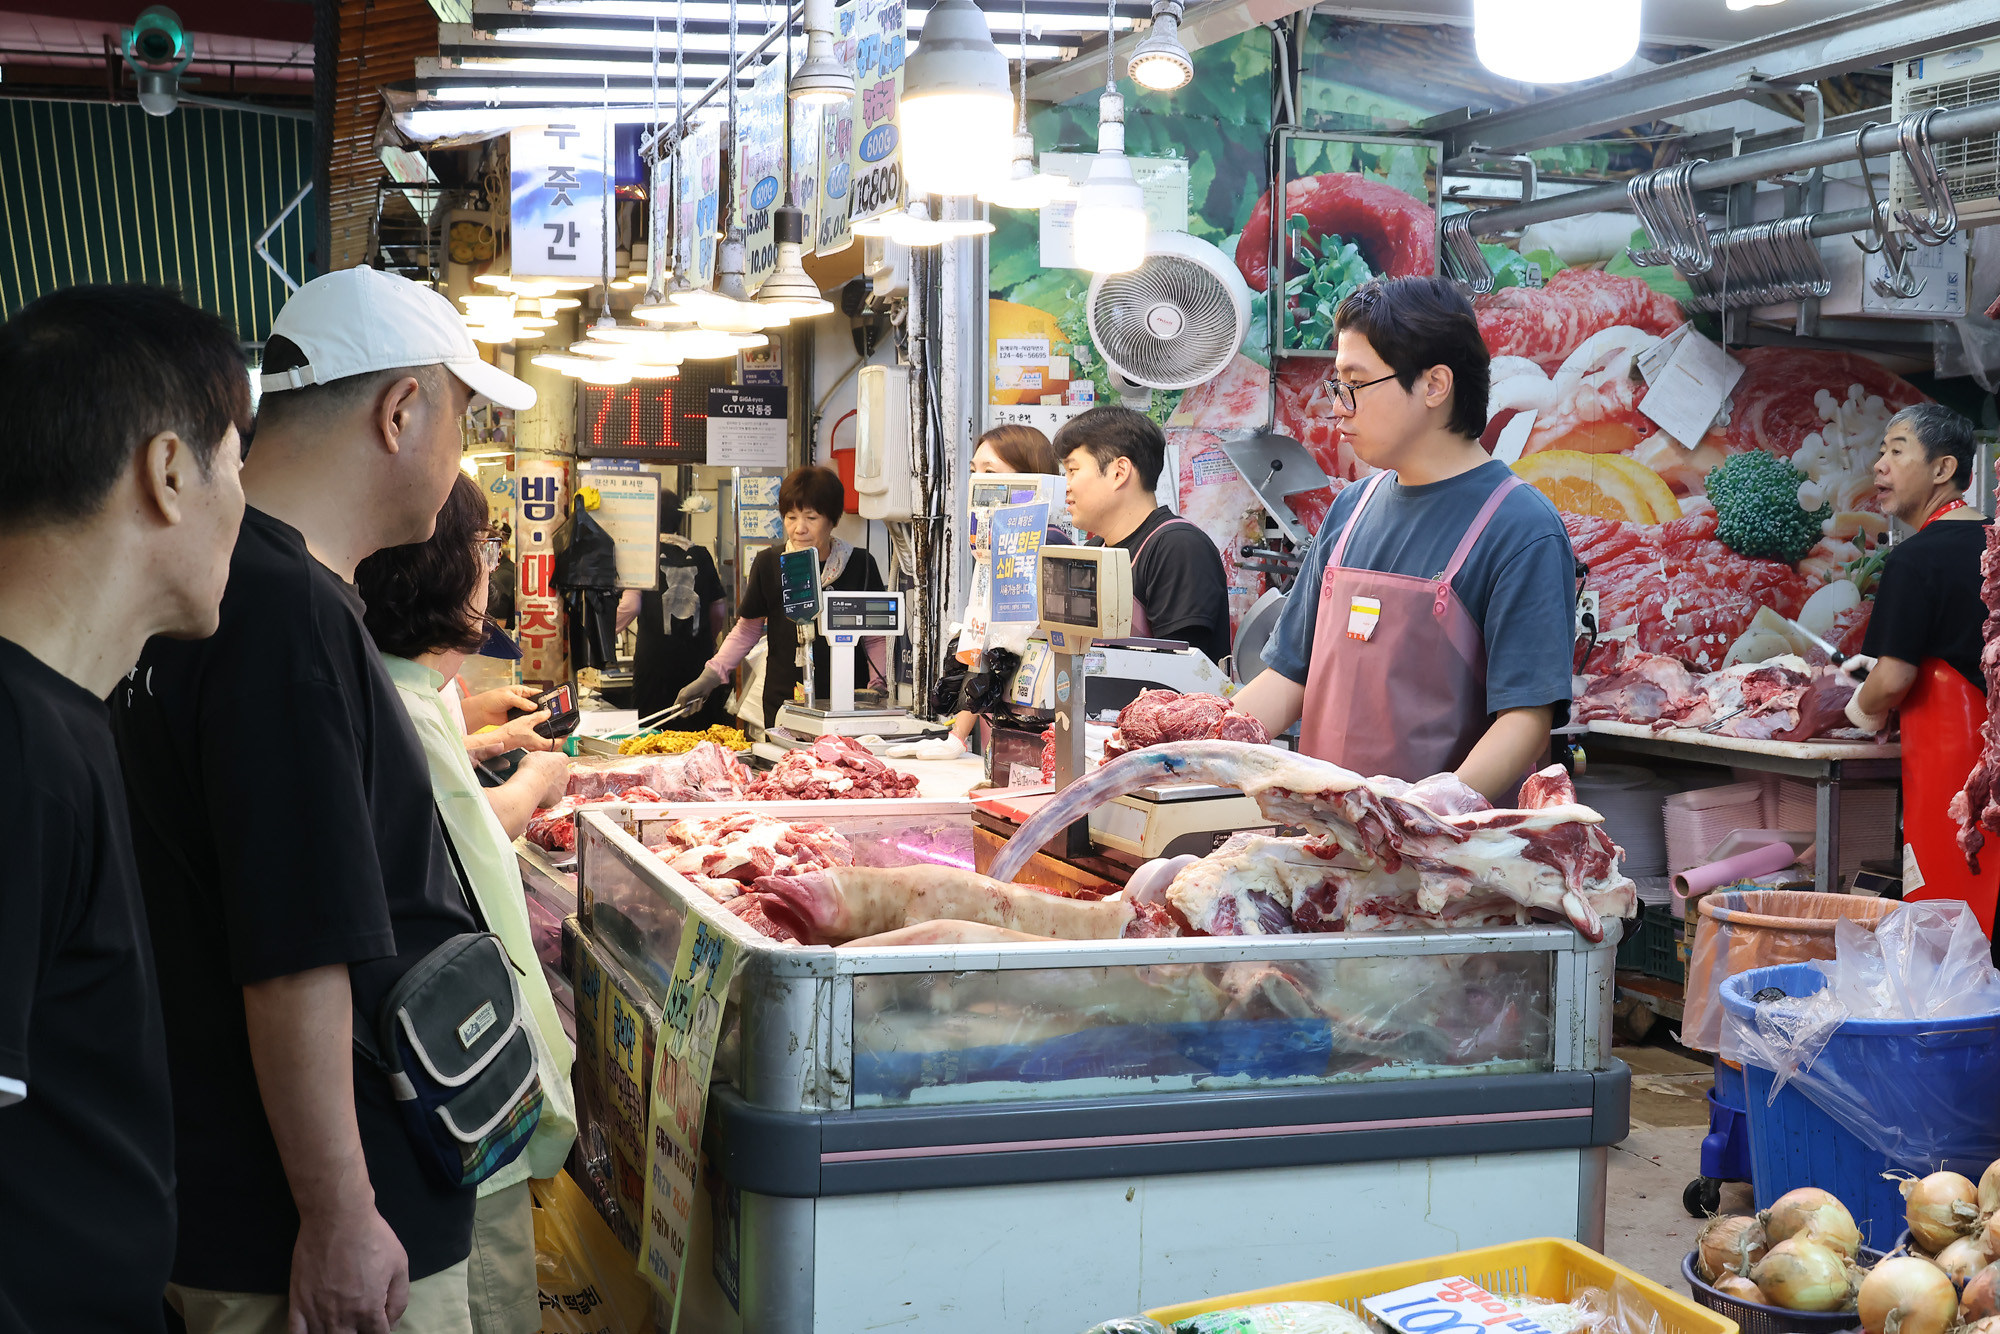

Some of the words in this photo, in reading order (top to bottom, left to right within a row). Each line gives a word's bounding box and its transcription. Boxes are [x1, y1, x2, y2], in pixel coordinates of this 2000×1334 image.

[866, 128, 891, 159] 600G
[722, 404, 745, 414] CCTV
[746, 404, 772, 416] 작동중
[1007, 517, 1017, 527] 우리
[997, 530, 1042, 556] 민생회복
[995, 554, 1037, 581] 소비쿠폰
[689, 920, 726, 992] 국내산
